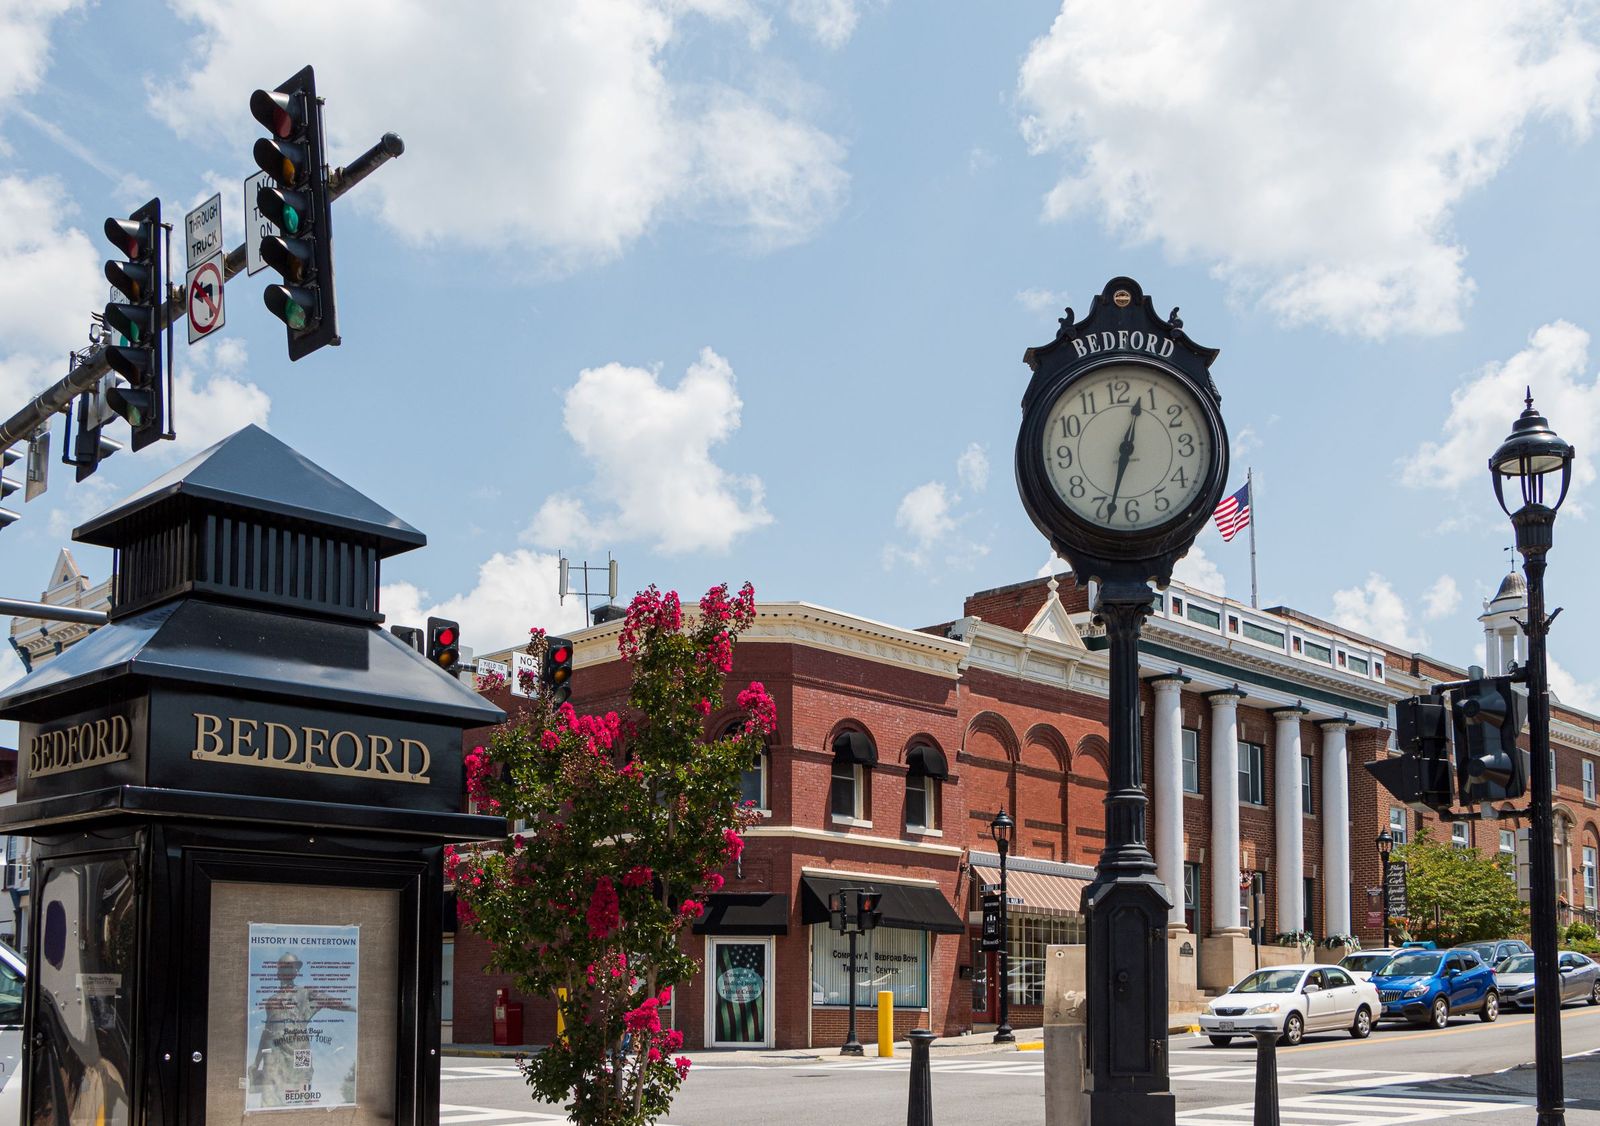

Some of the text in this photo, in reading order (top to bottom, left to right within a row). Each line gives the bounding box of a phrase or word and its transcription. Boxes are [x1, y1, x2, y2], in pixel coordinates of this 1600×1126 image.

[189, 203, 218, 233] THROUGH
[260, 222, 273, 239] ON
[192, 230, 218, 257] TRUCK
[1072, 330, 1175, 358] BEDFORD
[1079, 391, 1096, 415] 11
[1106, 380, 1130, 405] 12
[1148, 387, 1157, 410] 1
[1060, 414, 1081, 438] 10
[1167, 404, 1183, 428] 2
[1056, 445, 1073, 469] 9
[1177, 433, 1195, 458] 3
[1069, 475, 1085, 499] 8
[1170, 465, 1188, 489] 4
[1091, 496, 1109, 521] 7
[1124, 499, 1140, 523] 6
[1154, 486, 1170, 512] 5
[520, 656, 533, 667] NO
[28, 715, 129, 779] BEDFORD
[192, 712, 431, 784] BEDFORD
[251, 937, 286, 945] HISTORY
[300, 938, 357, 946] CENTERTOWN
[832, 950, 918, 963] COMPNY A BEDFORD BOYS
[875, 966, 899, 974] CENTER
[284, 1028, 324, 1036] Bedford Boys
[316, 1035, 332, 1045] TOUR
[285, 1092, 321, 1101] BEDFORD
